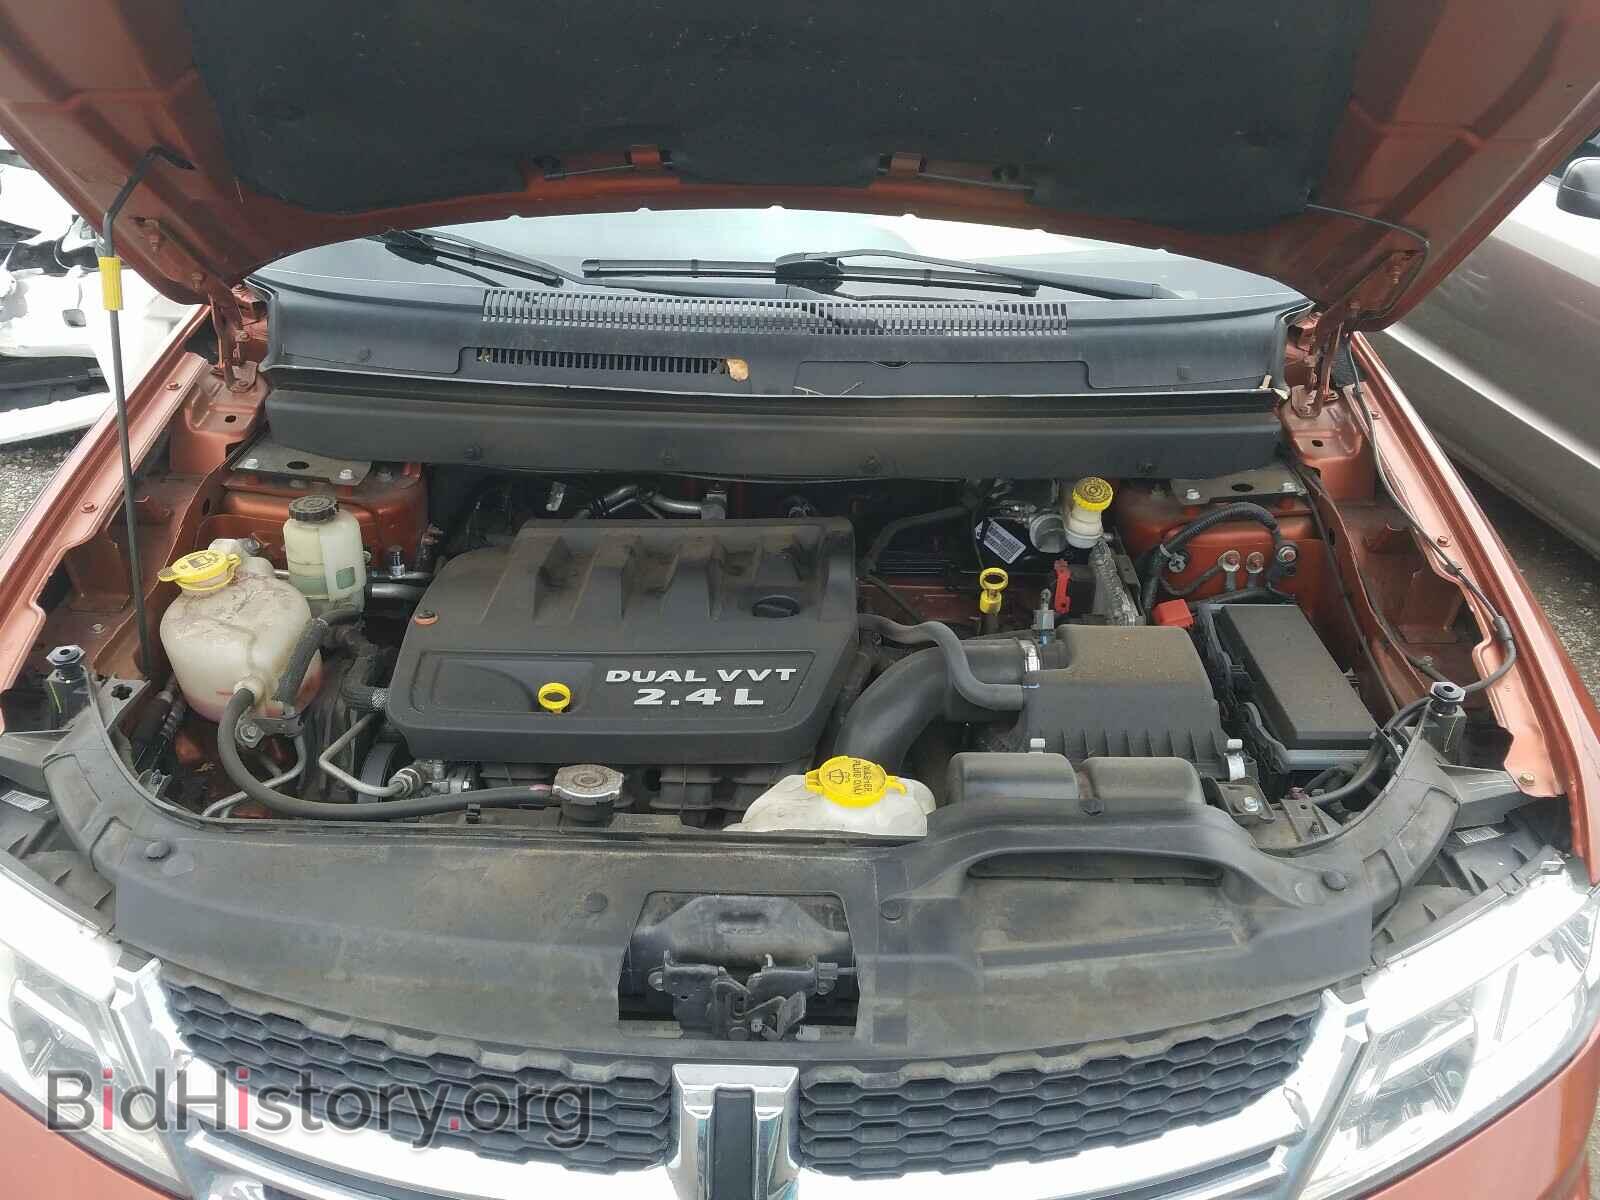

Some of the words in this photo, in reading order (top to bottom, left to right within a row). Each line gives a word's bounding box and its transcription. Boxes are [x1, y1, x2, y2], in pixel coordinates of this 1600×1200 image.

[605, 669, 707, 683] DUAL
[716, 667, 797, 682] VVT
[852, 759, 862, 778] FLUID
[853, 779, 863, 796] ONLY
[863, 764, 873, 793] WASHER
